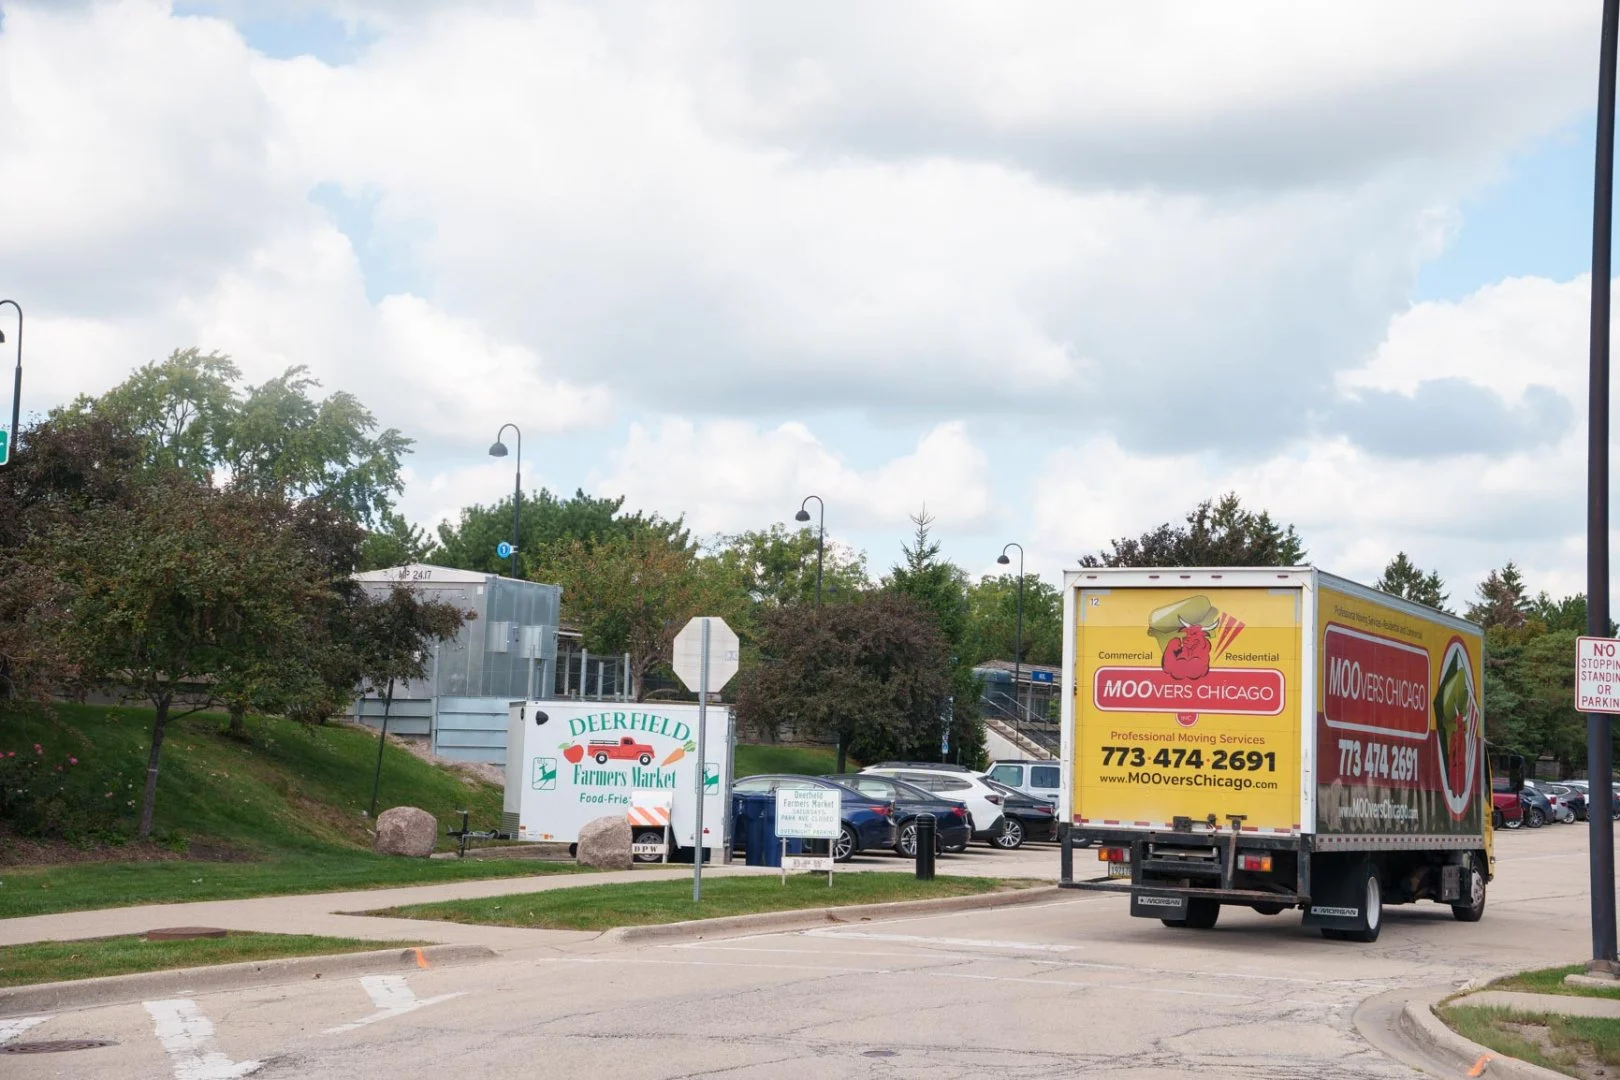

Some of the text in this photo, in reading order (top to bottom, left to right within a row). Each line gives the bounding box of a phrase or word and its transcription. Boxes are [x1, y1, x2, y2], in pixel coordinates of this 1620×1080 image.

[1098, 651, 1153, 660] Commercial
[1594, 643, 1615, 657] NO
[1225, 652, 1280, 662] Residential
[1581, 658, 1620, 671] STOPPIN
[1581, 671, 1620, 683] STANDIN
[1197, 684, 1274, 701] CHICAGO
[1385, 677, 1425, 711] CHICAGO
[1597, 684, 1611, 695] OR
[1581, 696, 1620, 708] PARKIN
[569, 712, 690, 741] DEERFIELD
[1110, 731, 1265, 745] Professional Moving Services
[1338, 739, 1418, 781] 773 474 2691
[573, 764, 677, 788] Farmers Market
[1099, 771, 1278, 791] www.MOOversChicago.com
[580, 792, 632, 805] Food-Frie
[783, 799, 834, 809] Farmers Market
